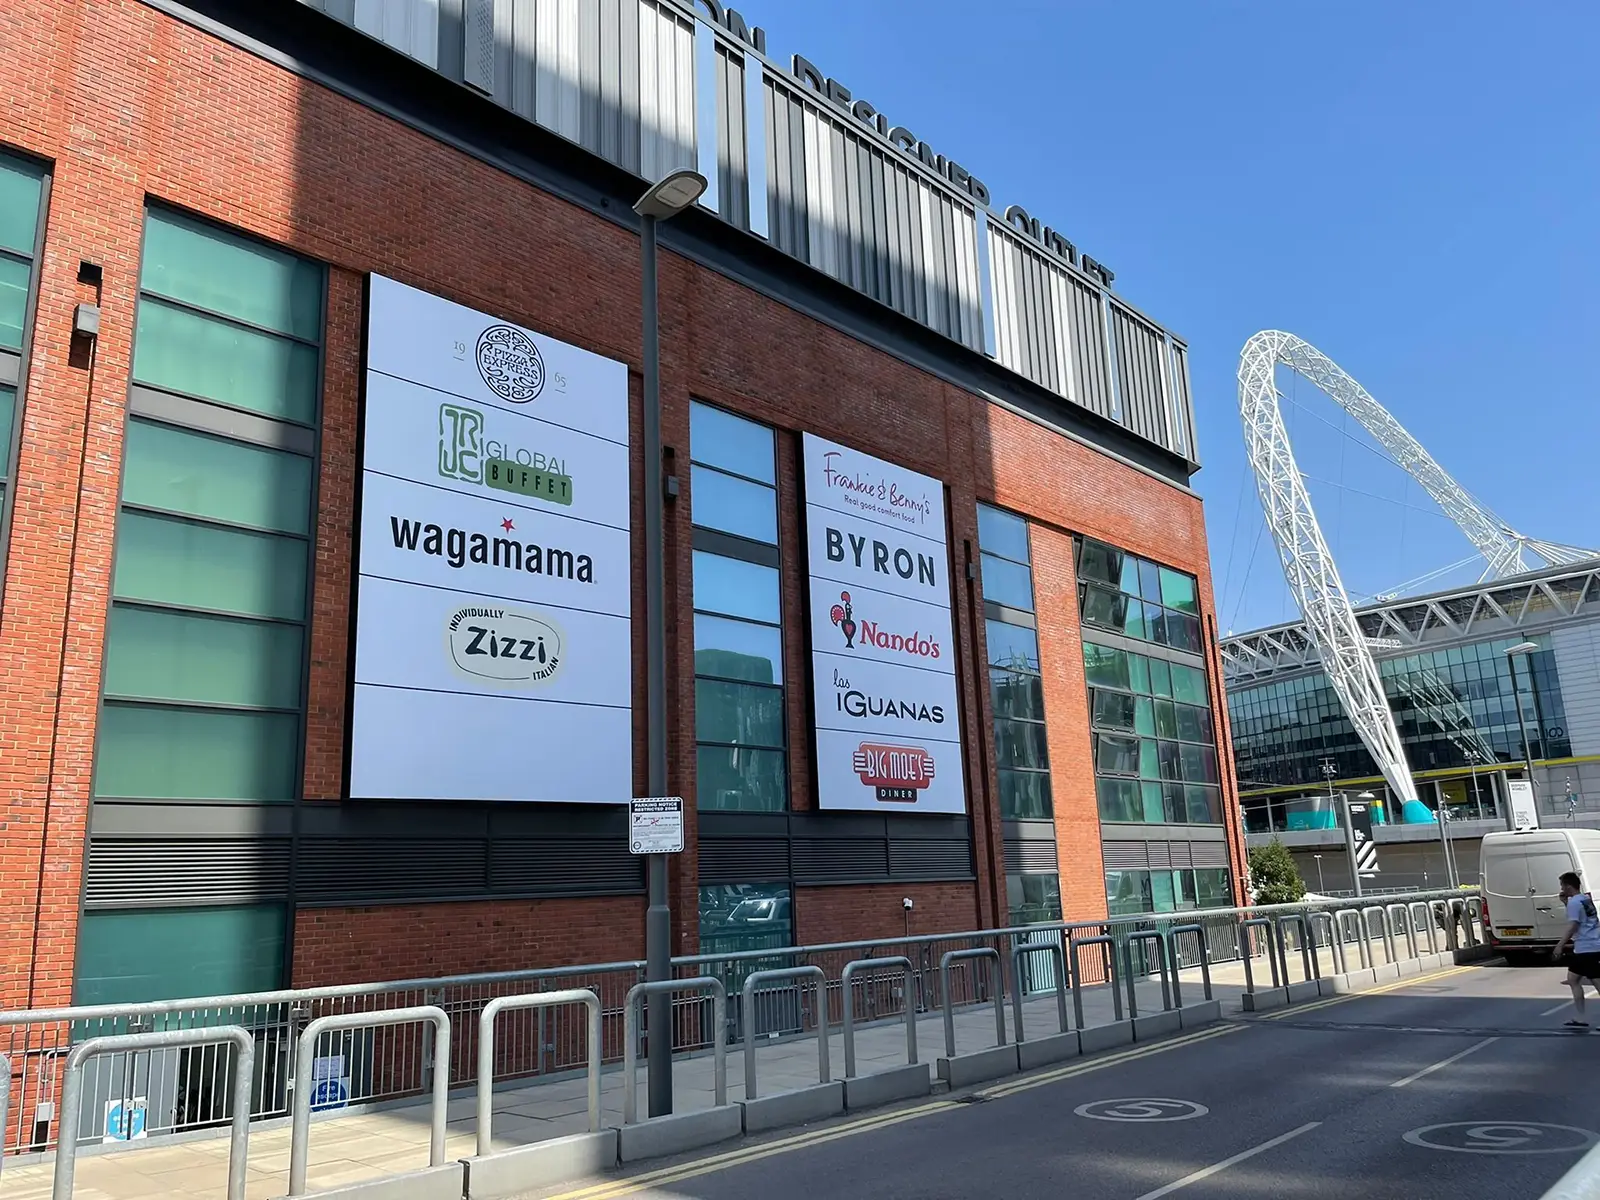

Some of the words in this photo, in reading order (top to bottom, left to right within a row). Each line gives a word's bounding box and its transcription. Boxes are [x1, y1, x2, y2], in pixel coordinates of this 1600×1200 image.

[454, 340, 466, 355] 19
[493, 347, 529, 368] PIZZA
[482, 353, 539, 380] EXPRESS
[554, 371, 567, 388] 65
[486, 440, 573, 479] GLOBAL
[492, 464, 567, 497] BUFFET
[823, 451, 875, 497] Frankie
[877, 478, 887, 501] &
[889, 482, 931, 525] Benny's
[844, 494, 859, 506] Real
[859, 501, 877, 513] good
[877, 506, 901, 519] comfort
[901, 513, 916, 524] food
[390, 515, 594, 584] wagamama
[825, 527, 936, 587] BYRON
[449, 608, 504, 632] INDIVIDUALLY
[464, 625, 547, 664] Zizzi
[859, 619, 940, 659] Nando's
[532, 656, 559, 681] ITALIAN
[833, 668, 851, 689] las
[837, 690, 945, 724] IGUANAS
[866, 748, 888, 779] BIG
[889, 751, 924, 781] MOE'S
[880, 789, 913, 799] DINER
[1104, 1100, 1184, 1118] 5
[1464, 1126, 1543, 1147] 5
